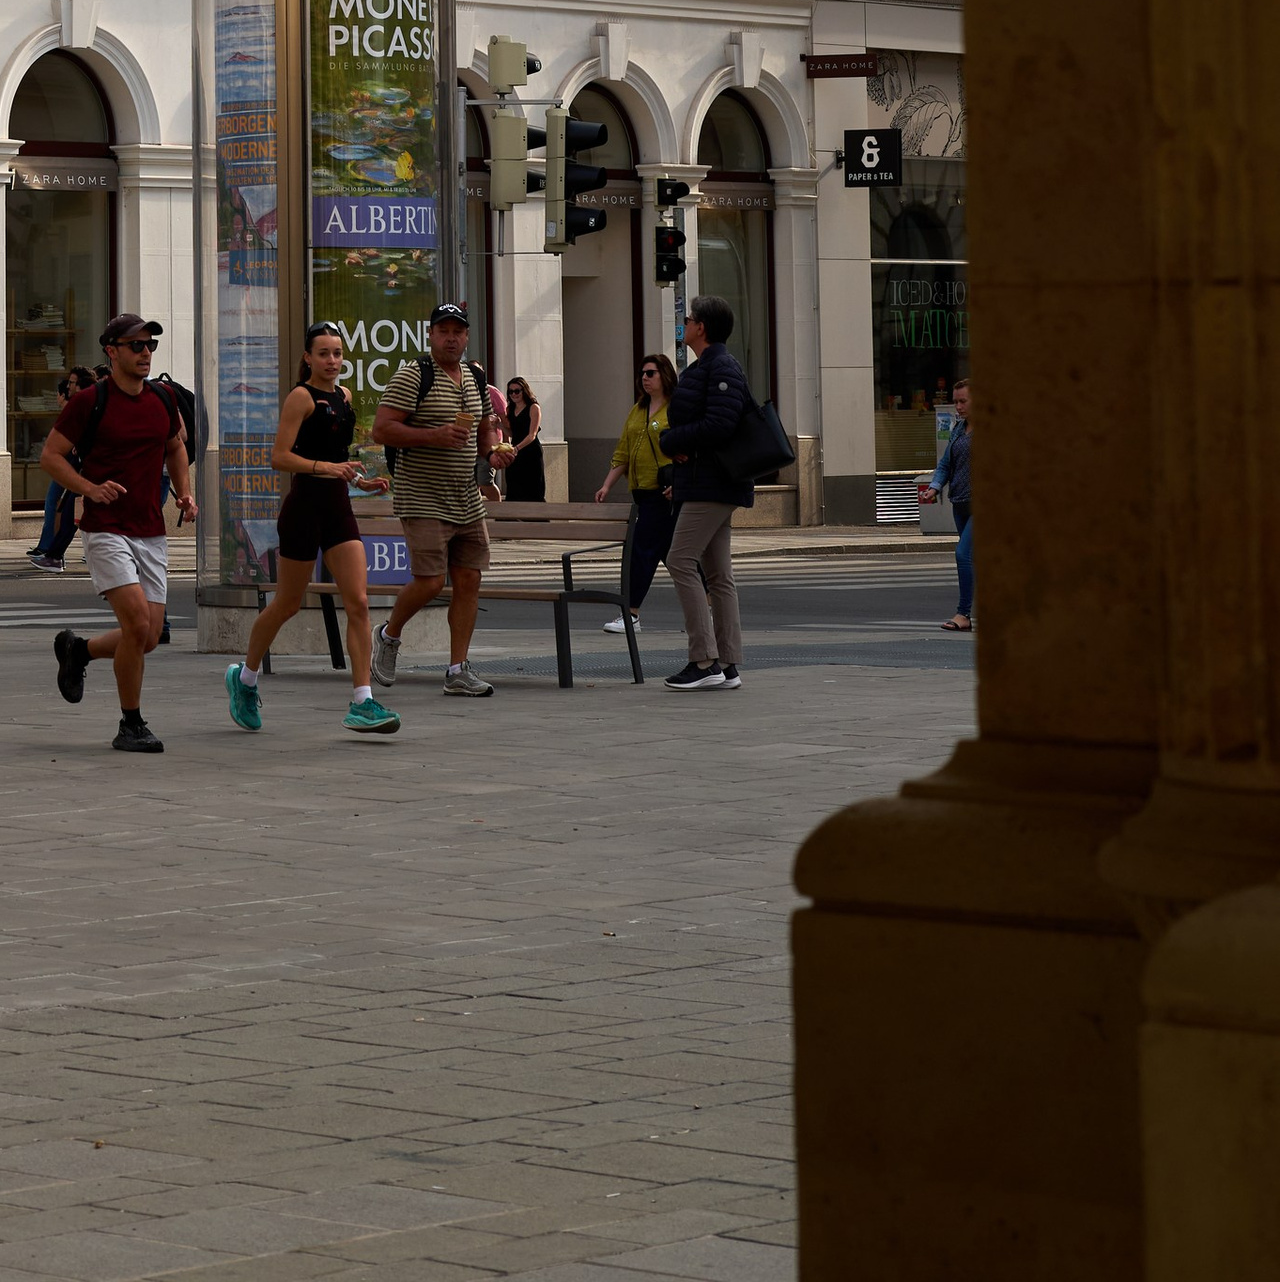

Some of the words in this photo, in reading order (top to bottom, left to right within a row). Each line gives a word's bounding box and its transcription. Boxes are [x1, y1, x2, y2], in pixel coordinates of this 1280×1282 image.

[329, 62, 349, 70] DIE
[356, 62, 415, 72] SAMMLUNG
[809, 63, 838, 71] ZARA
[843, 62, 874, 70] HOME
[22, 174, 61, 185] ZARA
[67, 175, 107, 186] HOME
[848, 173, 872, 181] PAPER
[879, 172, 894, 180] TEA
[602, 195, 635, 205] HOME
[703, 196, 733, 206] ZARA
[737, 197, 768, 207] HOME
